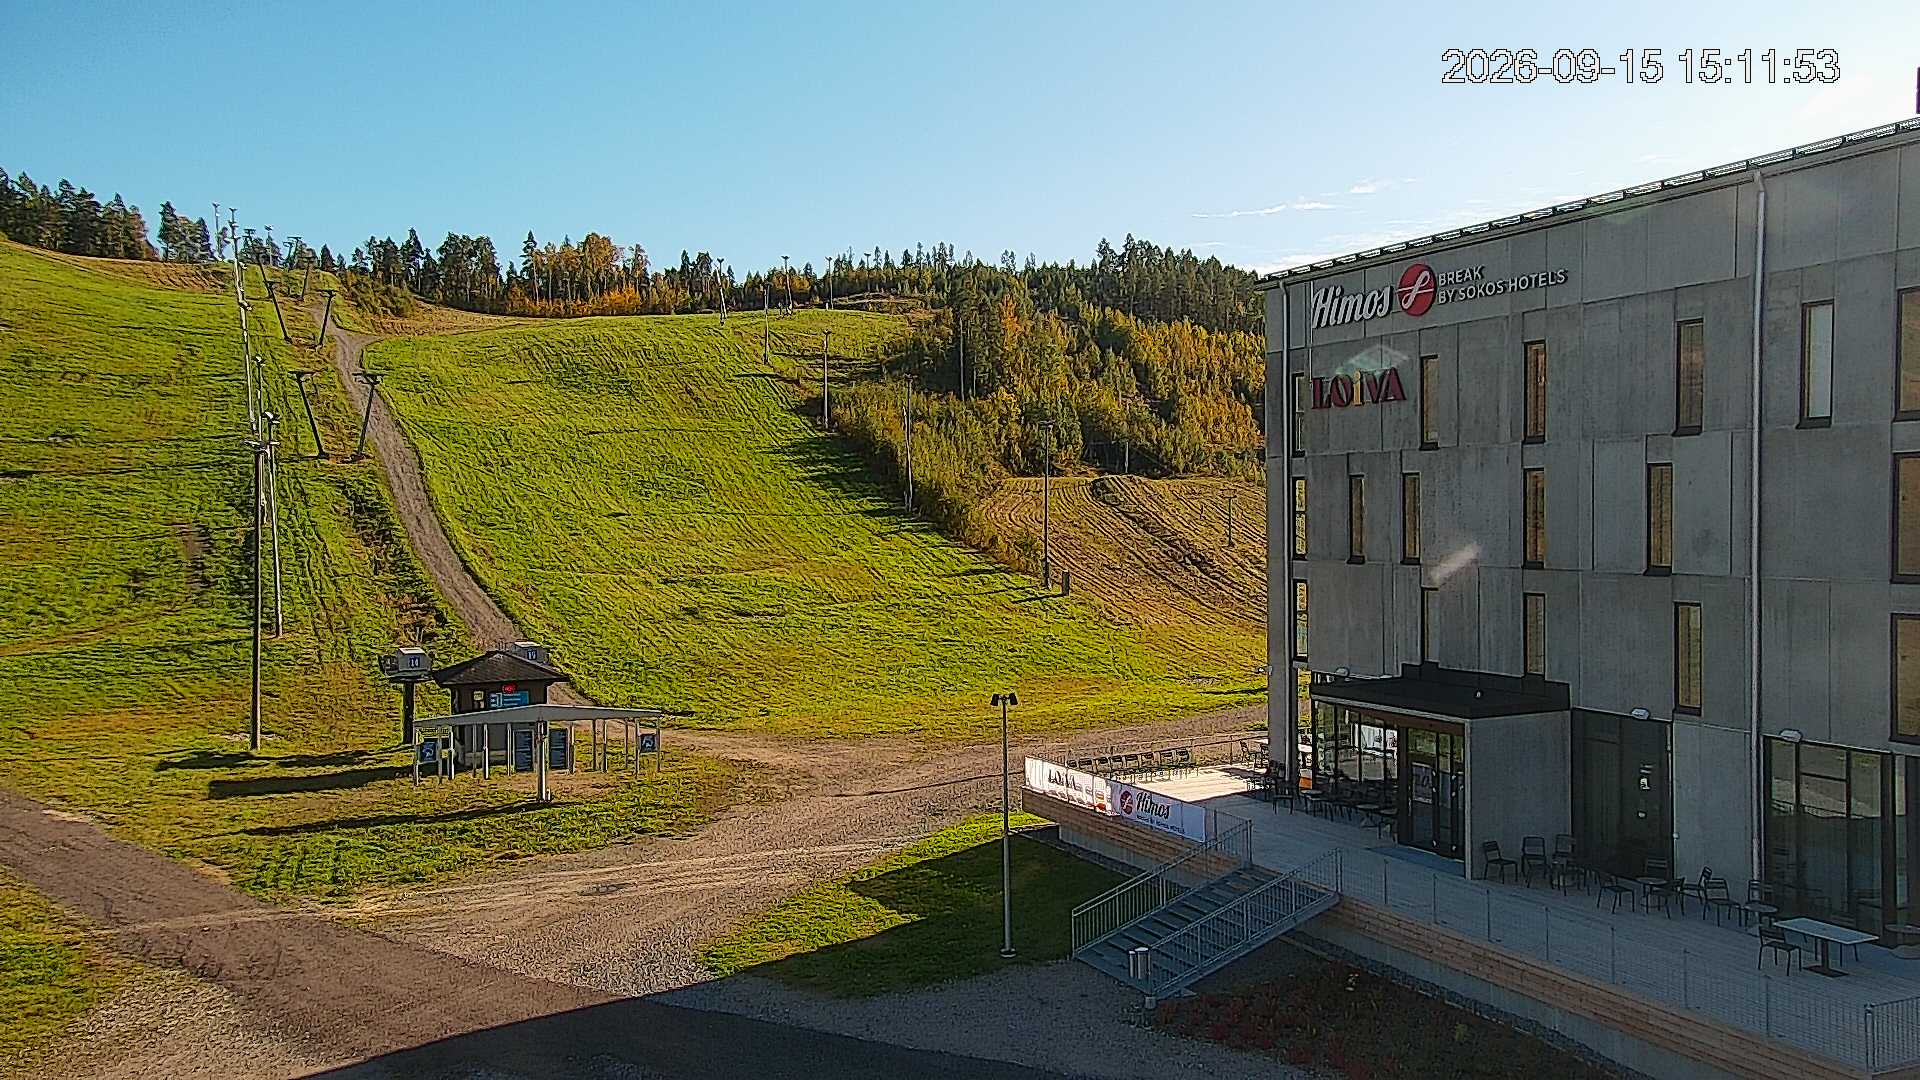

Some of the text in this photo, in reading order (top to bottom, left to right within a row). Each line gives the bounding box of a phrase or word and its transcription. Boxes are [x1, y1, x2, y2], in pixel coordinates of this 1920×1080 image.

[1438, 268, 1568, 304] BY SOKOS HOTELS
[1439, 265, 1484, 287] BREAK
[1312, 284, 1391, 328] Himos
[1136, 791, 1170, 820] Himos
